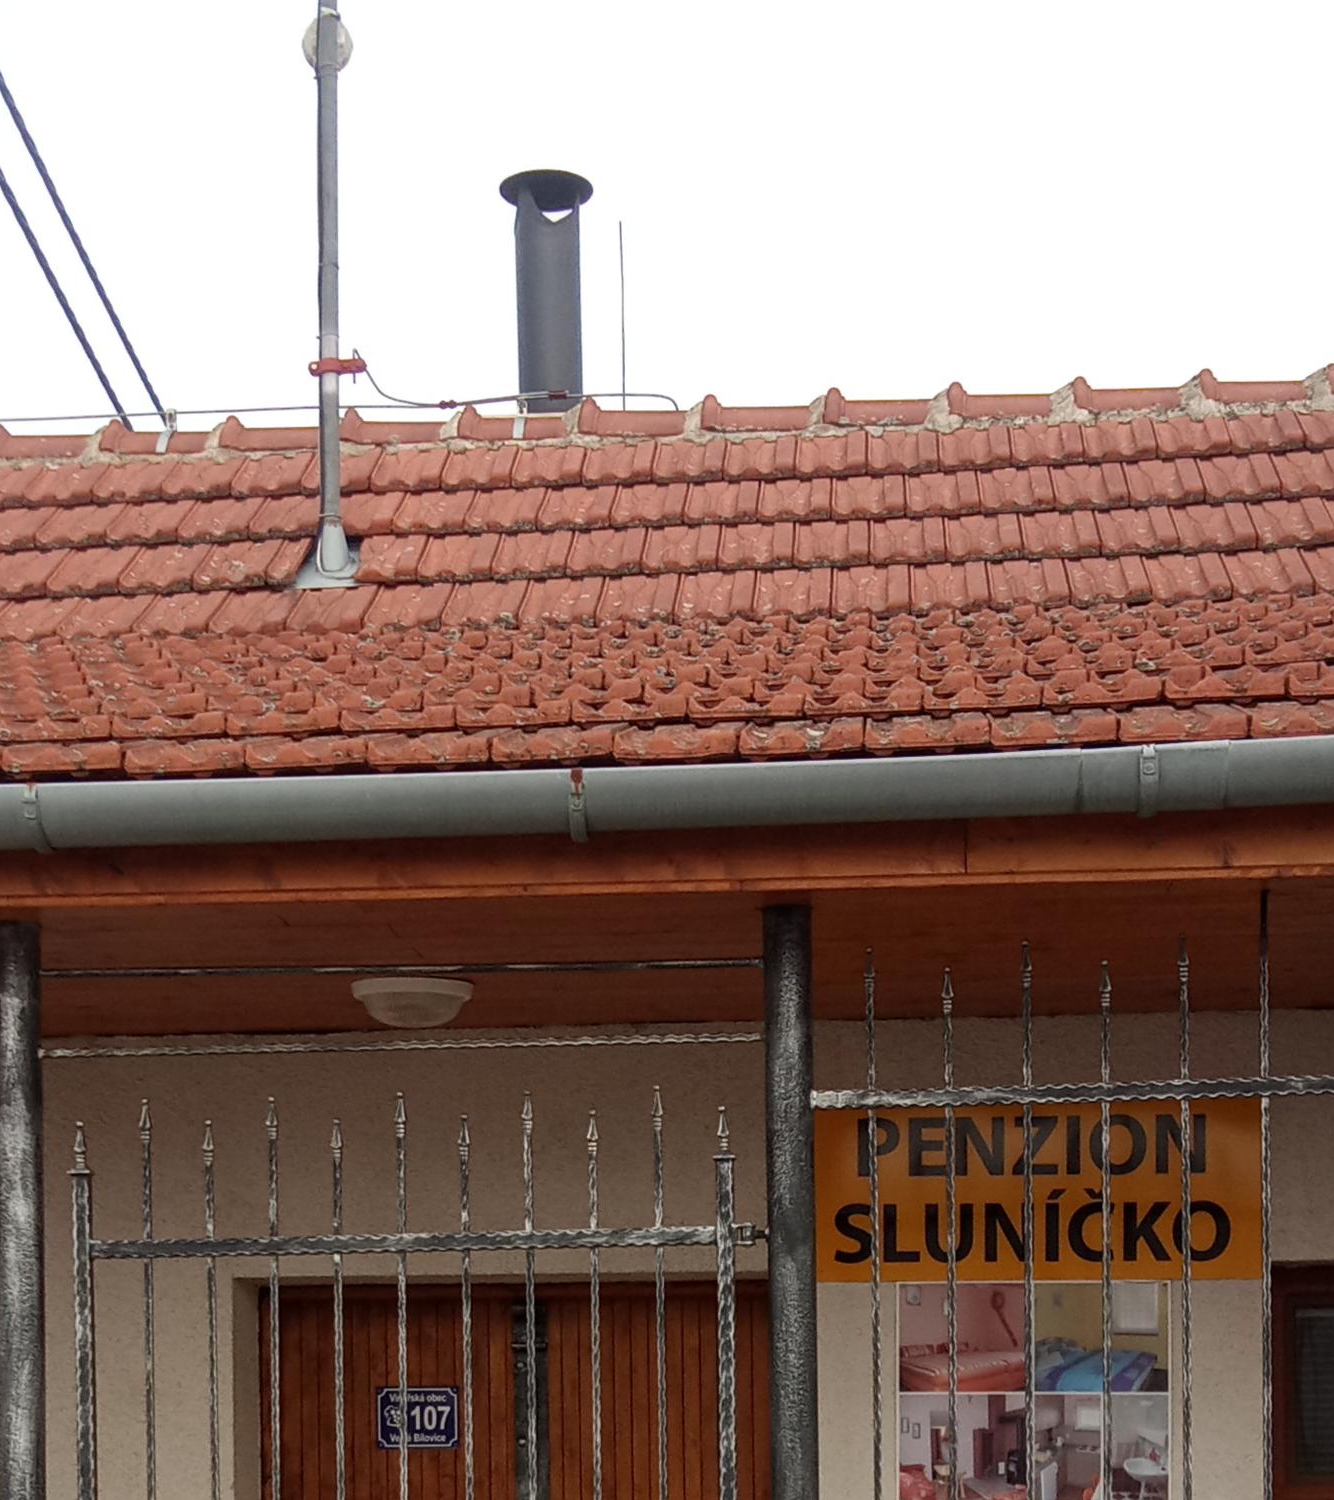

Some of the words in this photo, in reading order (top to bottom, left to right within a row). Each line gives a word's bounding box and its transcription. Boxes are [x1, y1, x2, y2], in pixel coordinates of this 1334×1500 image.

[856, 1112, 1207, 1177] PENZION
[834, 1188, 1232, 1264] SLUNÍČKO
[389, 1393, 425, 1402] Vinřská
[427, 1393, 447, 1402] obec
[410, 1405, 451, 1430] 107
